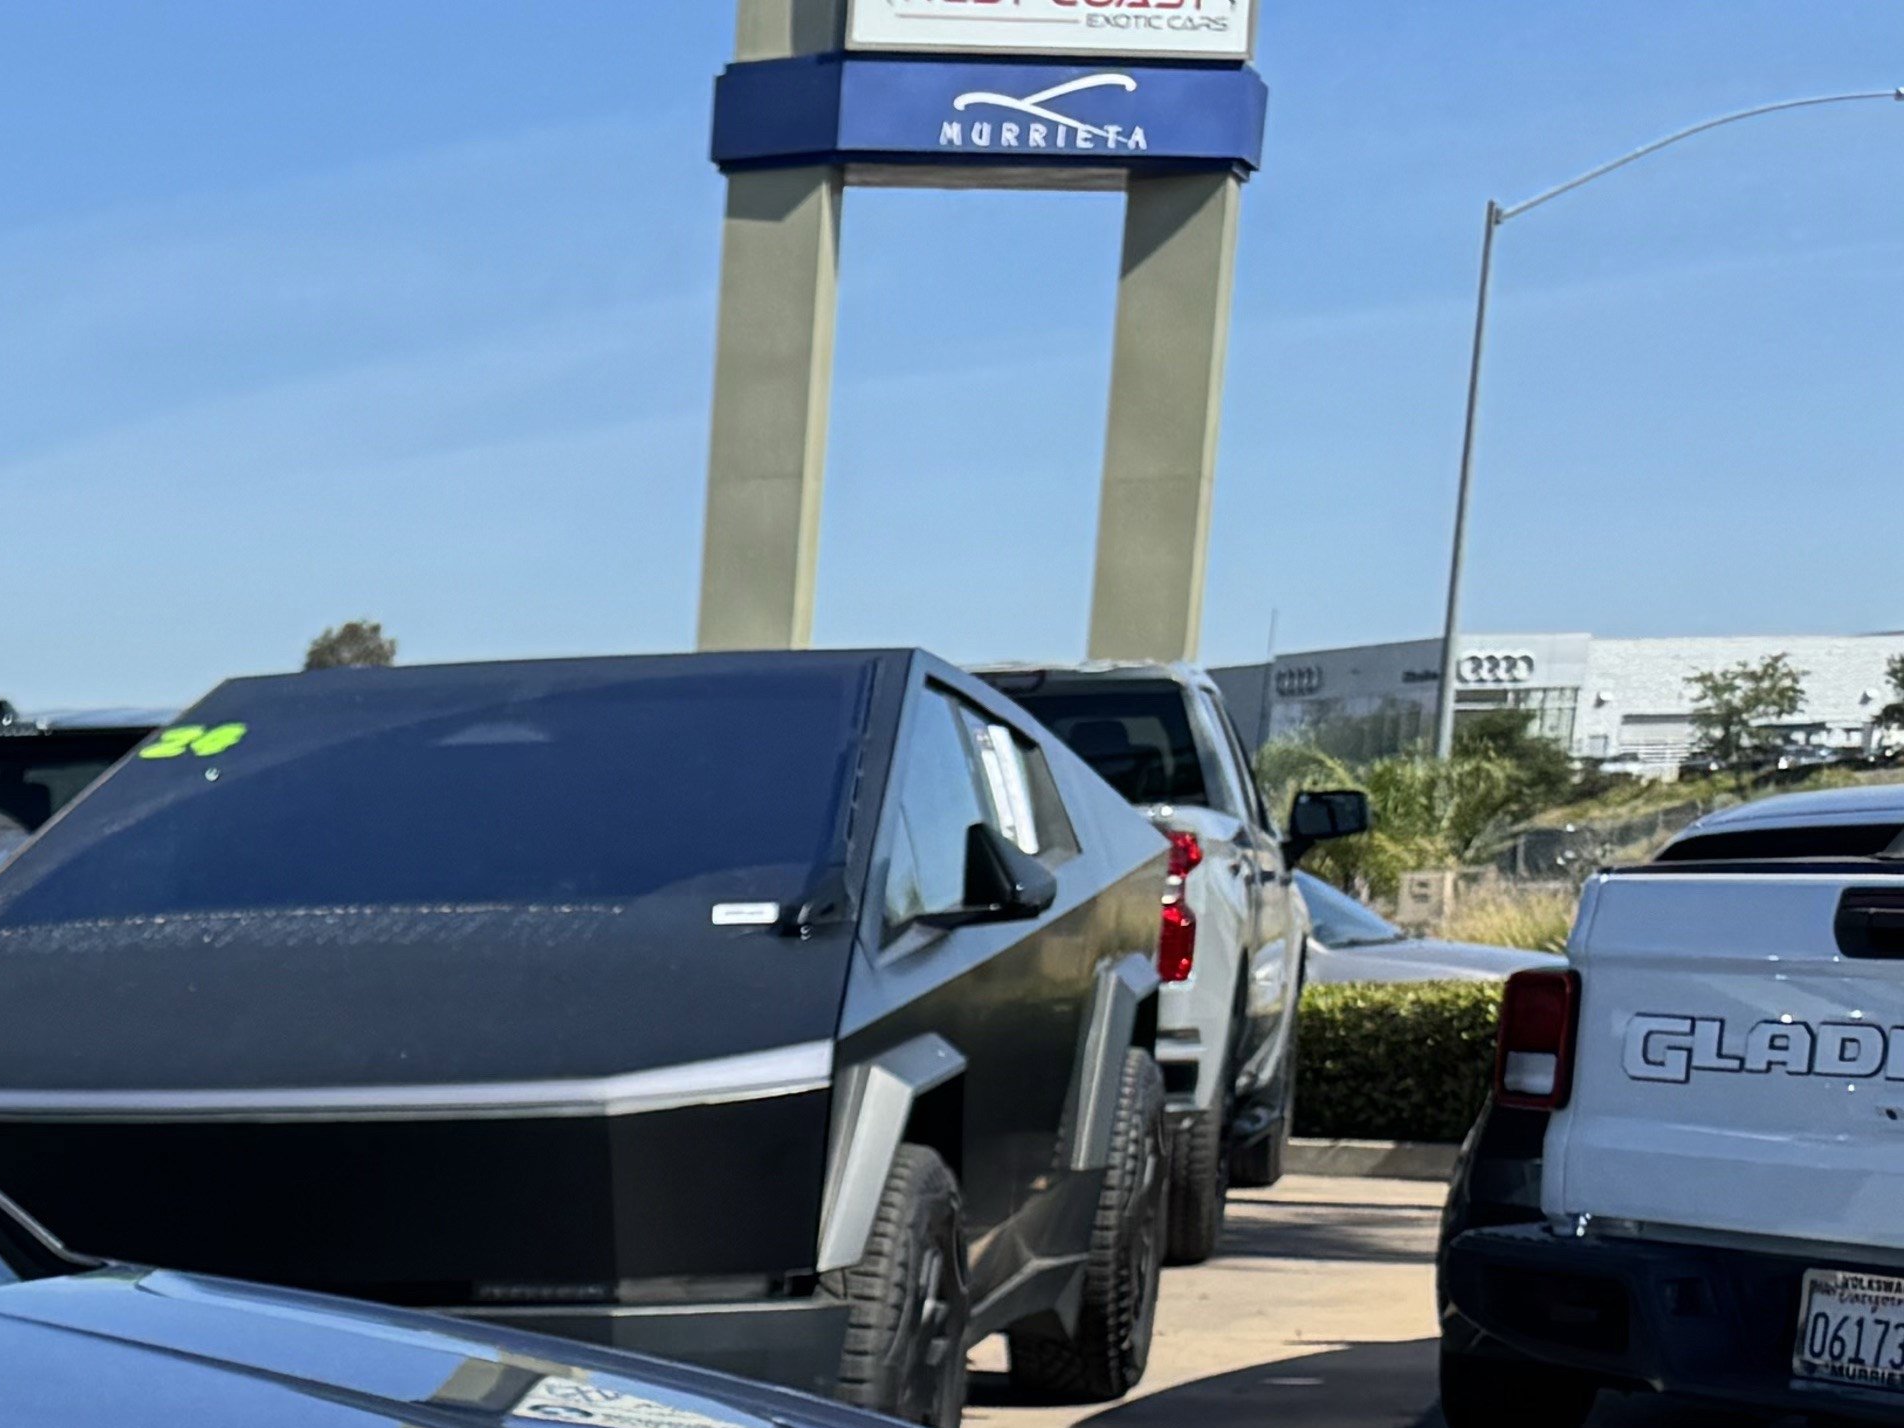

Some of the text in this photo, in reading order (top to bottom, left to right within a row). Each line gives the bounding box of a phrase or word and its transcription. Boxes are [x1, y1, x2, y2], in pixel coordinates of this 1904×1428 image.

[1085, 12, 1229, 32] EXOTIC CARS
[938, 120, 1148, 150] MURRIETA
